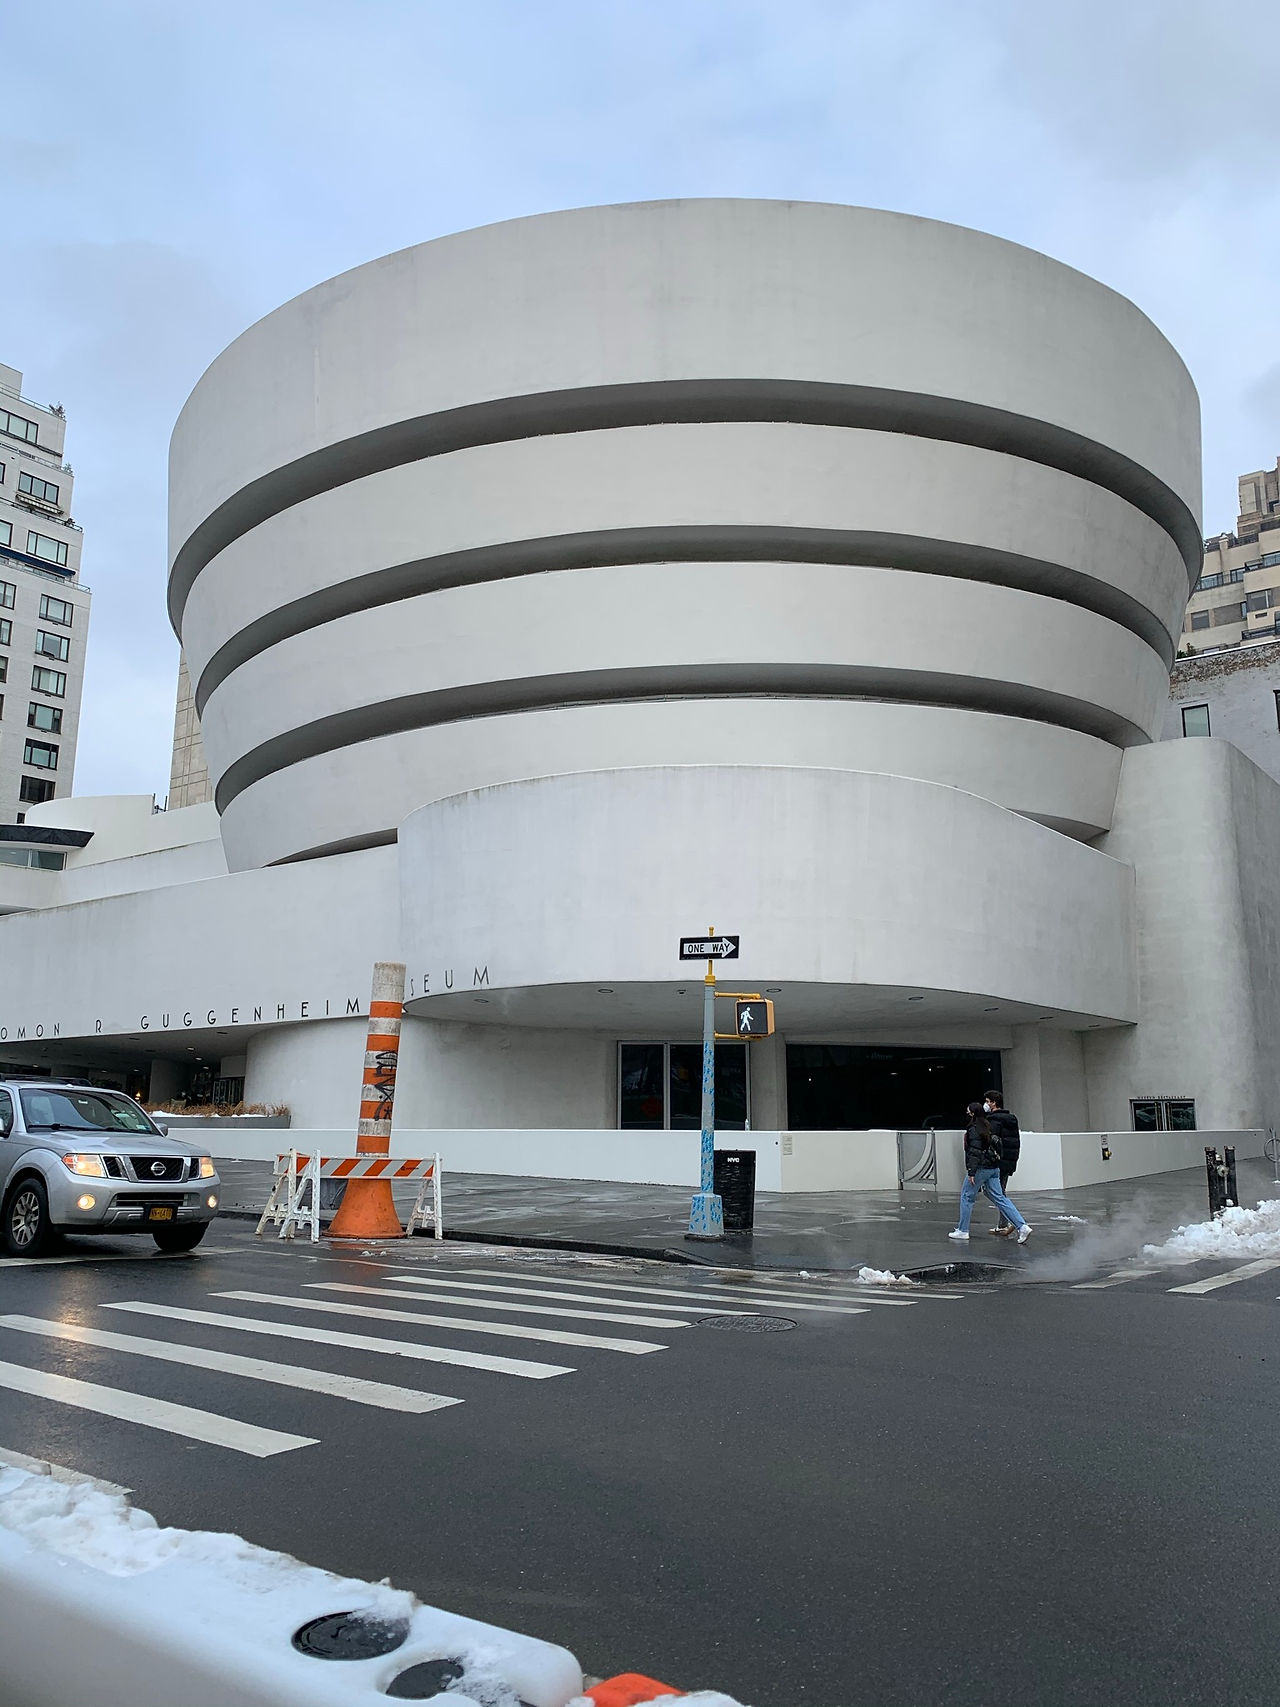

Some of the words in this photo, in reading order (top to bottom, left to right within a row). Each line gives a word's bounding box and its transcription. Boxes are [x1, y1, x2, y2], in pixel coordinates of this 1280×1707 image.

[687, 943, 705, 953] ONE
[712, 943, 730, 952] WAY
[95, 1019, 102, 1033] R
[140, 997, 360, 1030] GUGGENHEIM
[410, 966, 490, 996] SEUM
